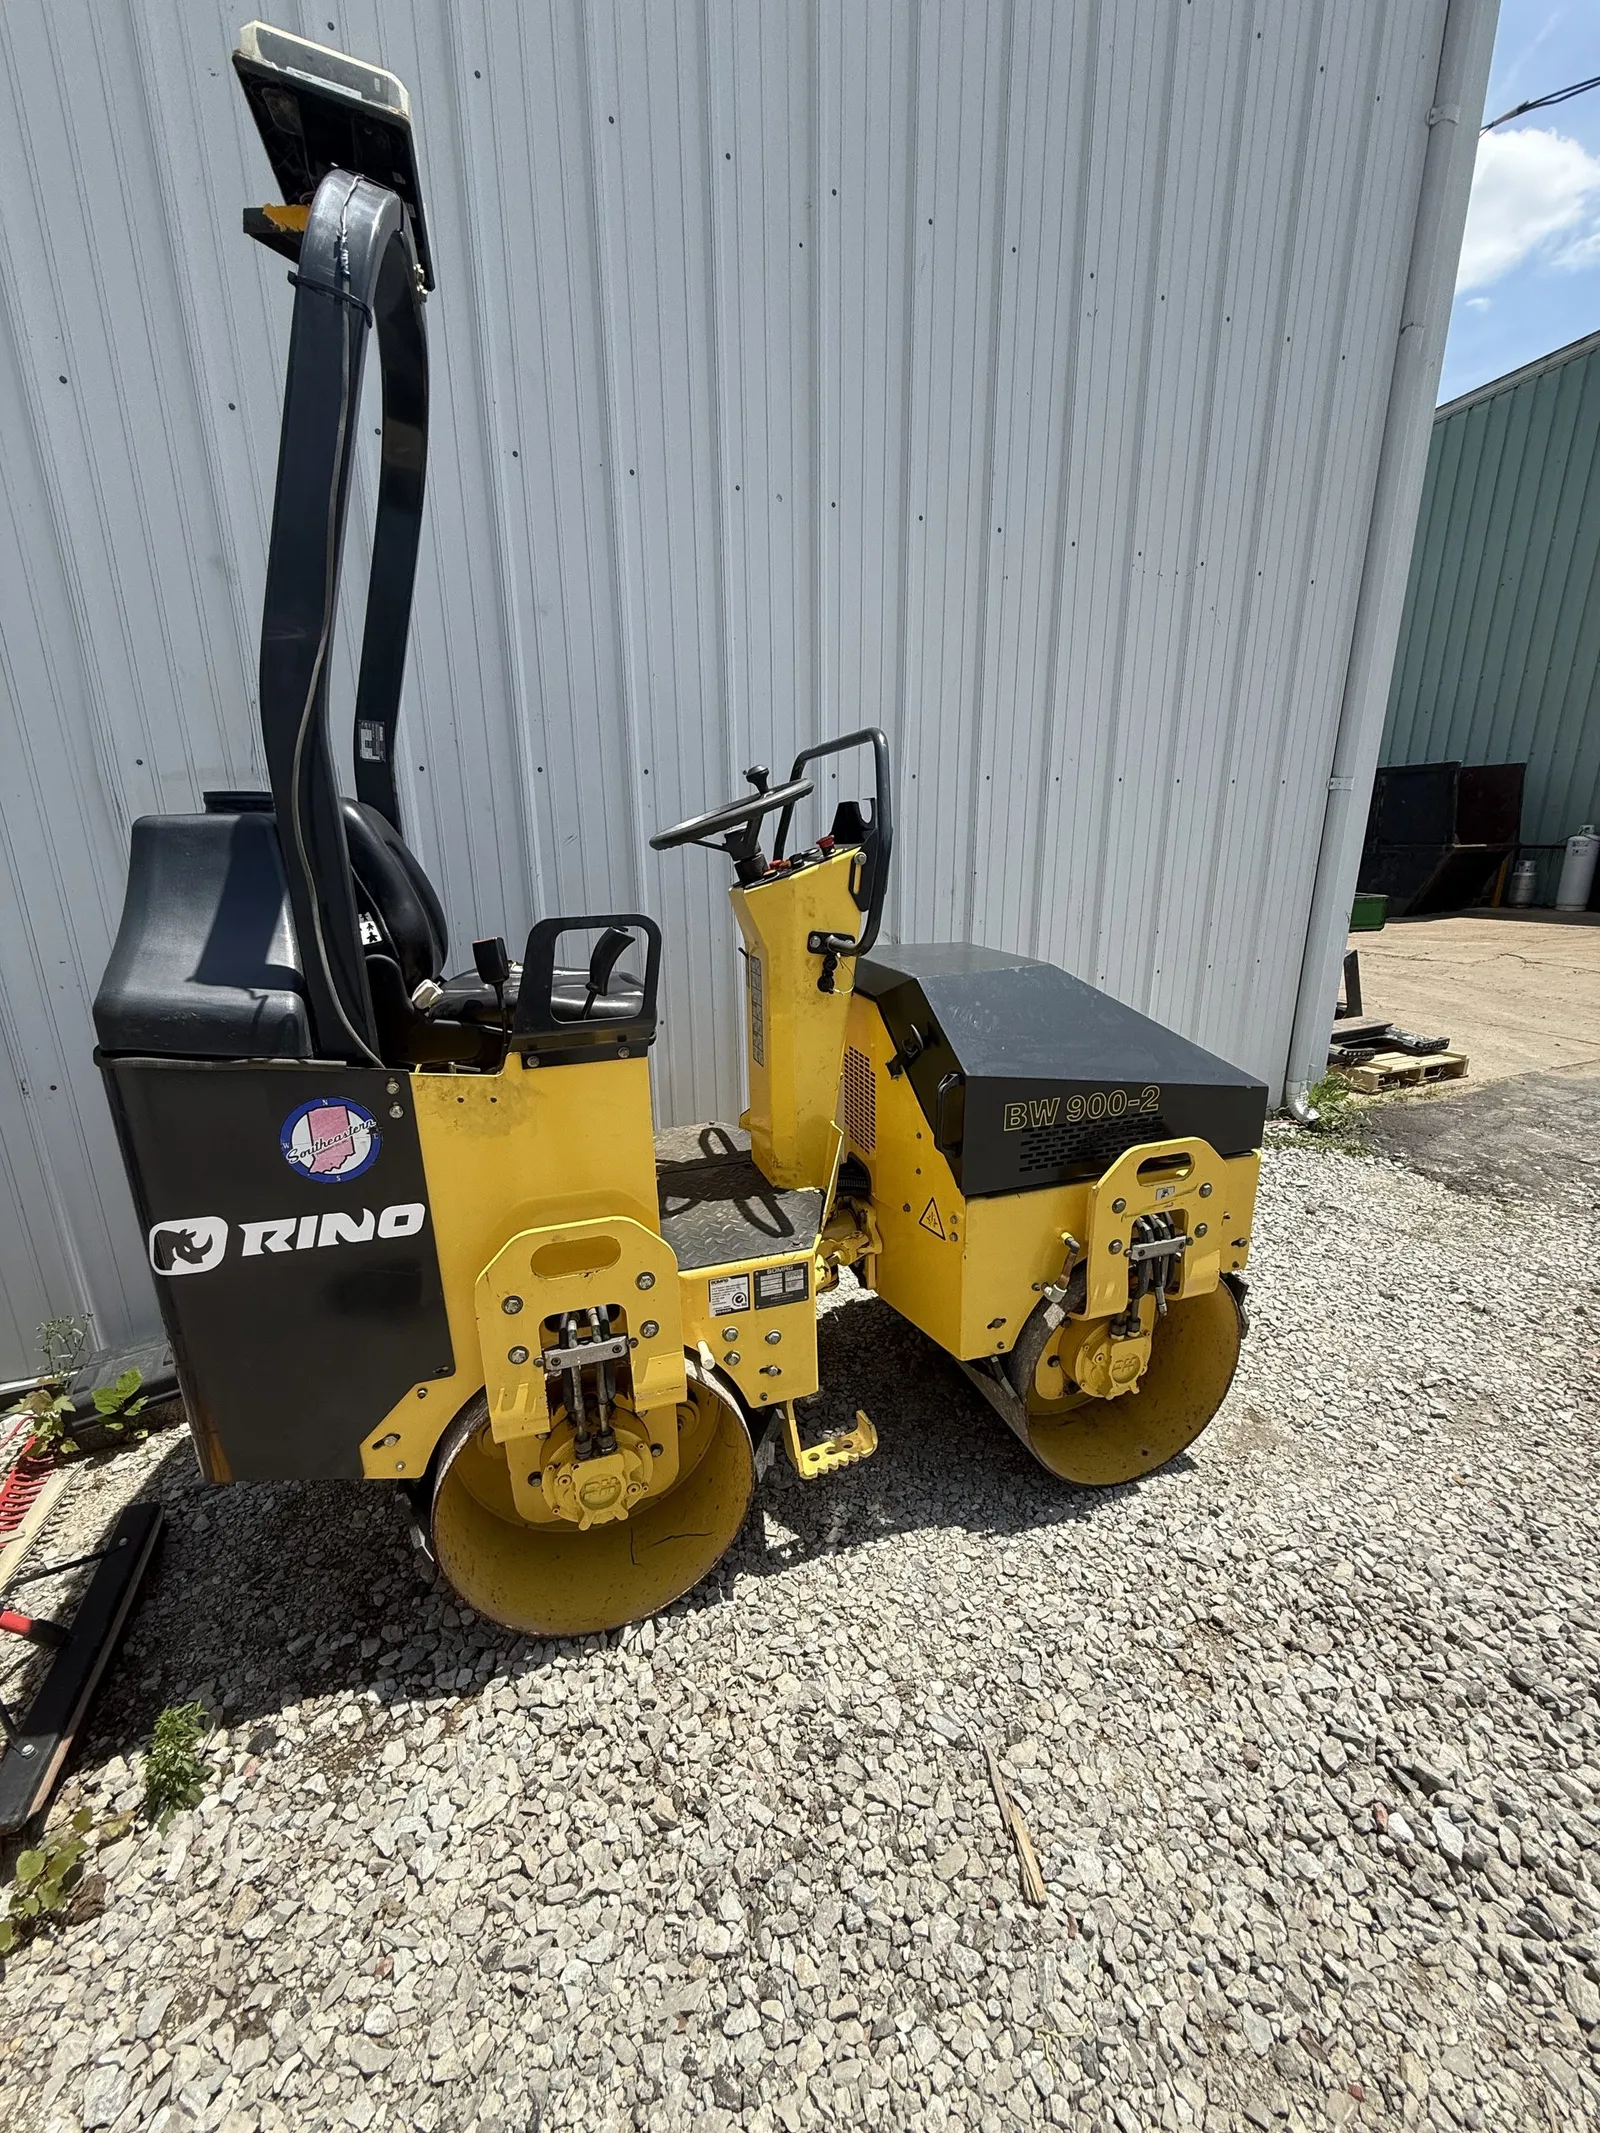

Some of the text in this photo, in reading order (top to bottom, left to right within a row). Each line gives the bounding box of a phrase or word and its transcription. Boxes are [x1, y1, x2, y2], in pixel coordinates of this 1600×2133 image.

[1003, 1085, 1161, 1132] BW 900-2
[286, 1119, 376, 1164] Southeastern
[238, 1202, 426, 1257] RINO
